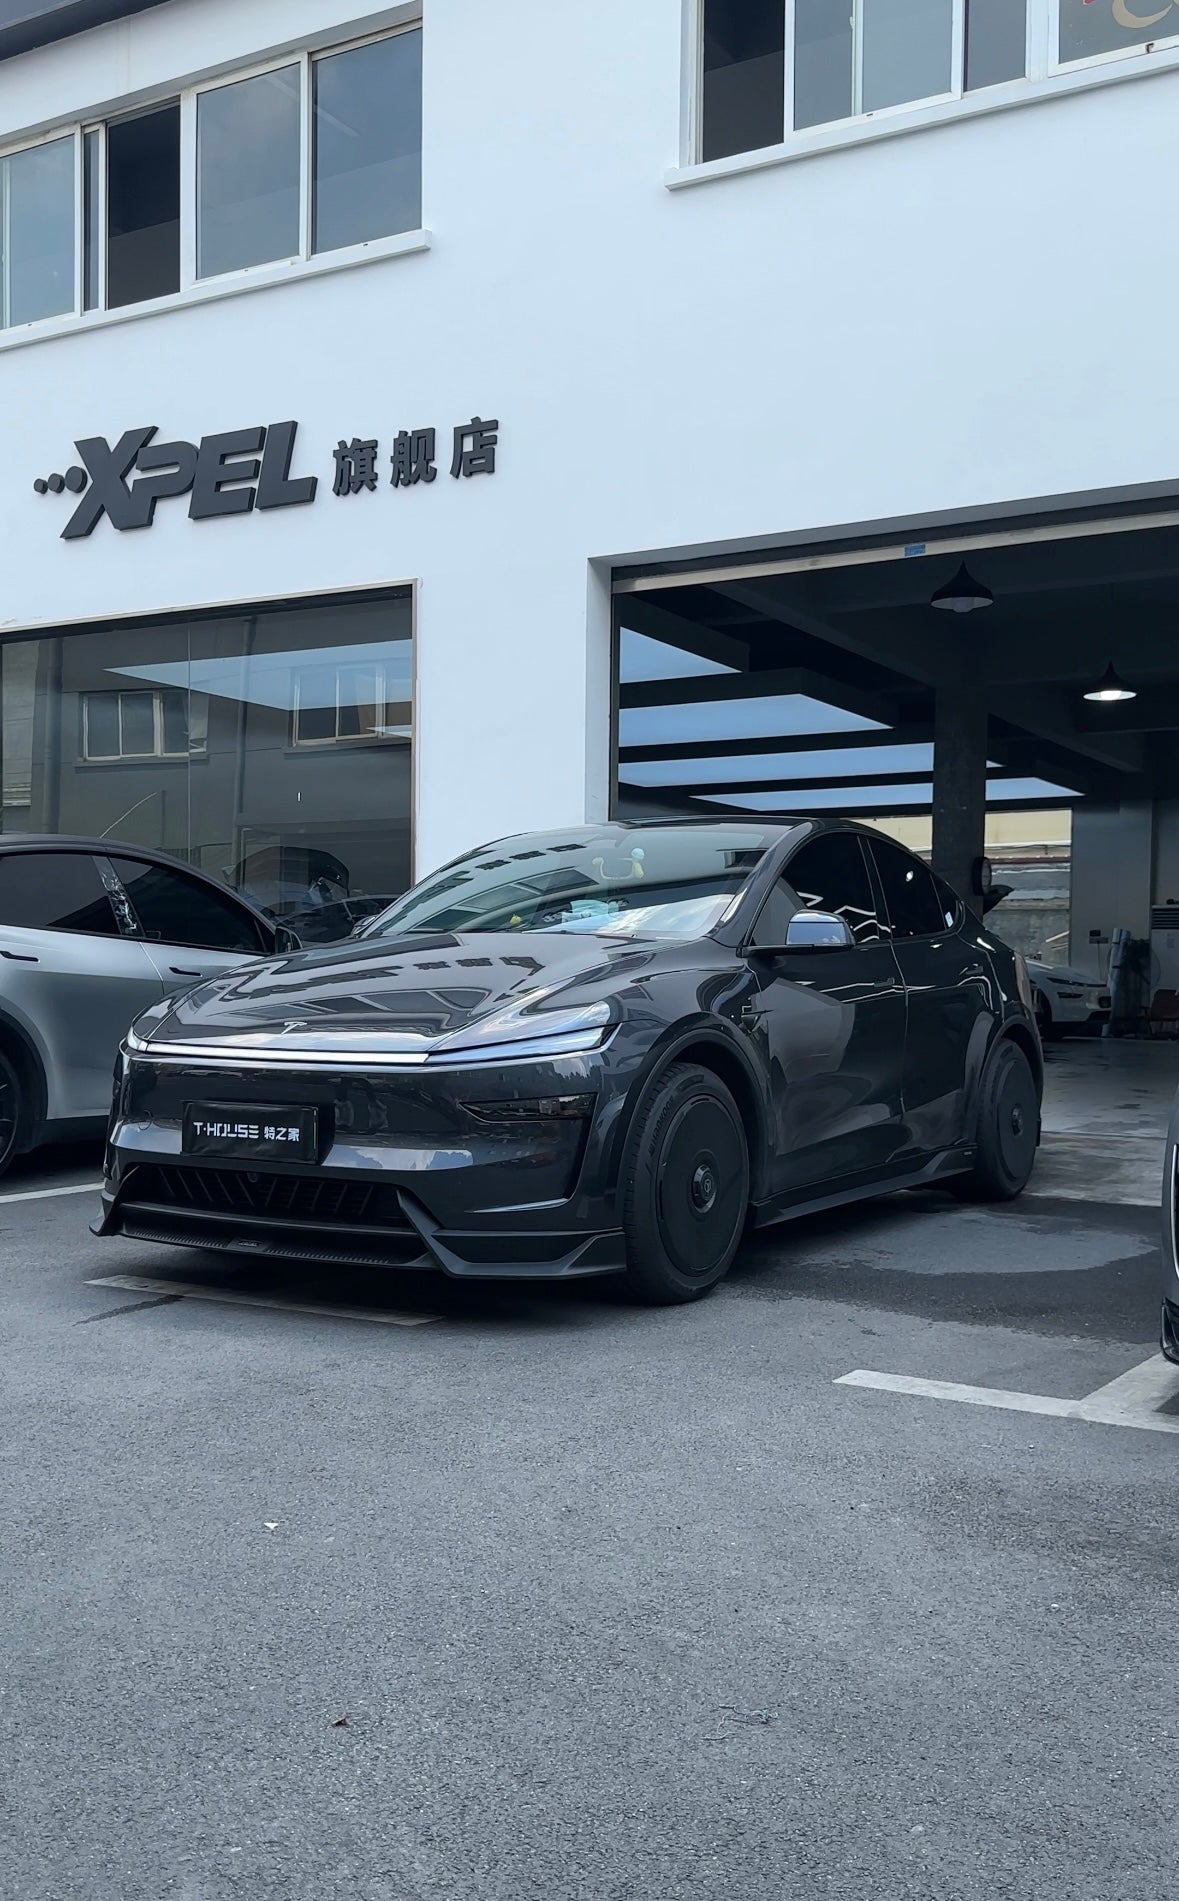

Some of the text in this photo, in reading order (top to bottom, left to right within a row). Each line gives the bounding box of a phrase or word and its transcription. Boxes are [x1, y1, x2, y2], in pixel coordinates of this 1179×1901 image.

[60, 416, 499, 540] XPEL 旗舰店
[264, 1125, 300, 1142] 特之家
